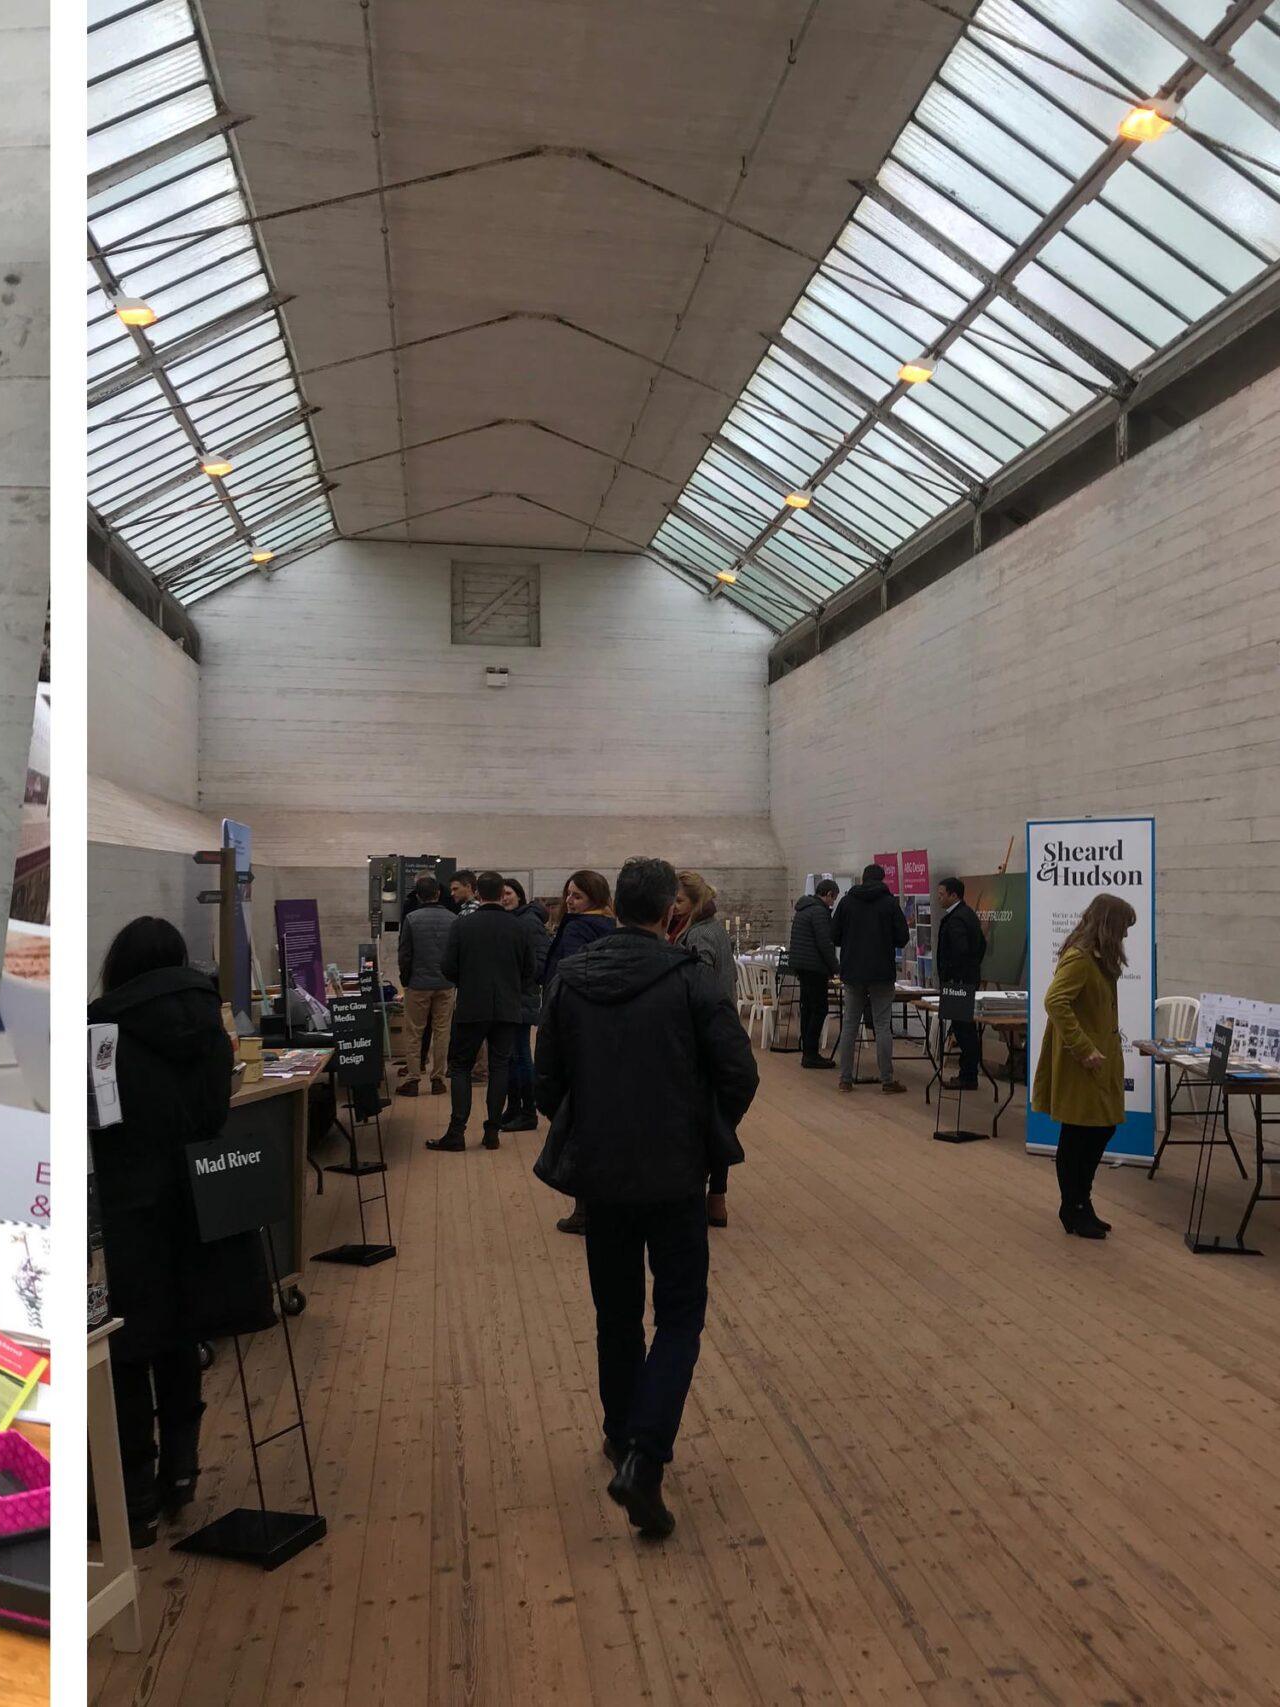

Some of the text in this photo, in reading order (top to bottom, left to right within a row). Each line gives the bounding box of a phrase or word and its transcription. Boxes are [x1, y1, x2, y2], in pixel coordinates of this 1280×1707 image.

[1043, 838, 1124, 863] Sheard
[912, 861, 926, 876] Design
[1051, 864, 1143, 887] Hudson
[949, 988, 967, 997] Studio
[332, 1002, 367, 1012] Pure Glow
[334, 1013, 356, 1023] Media
[337, 1040, 353, 1051] Tim
[339, 1053, 365, 1065] Design
[195, 1150, 261, 1175] Mad River
